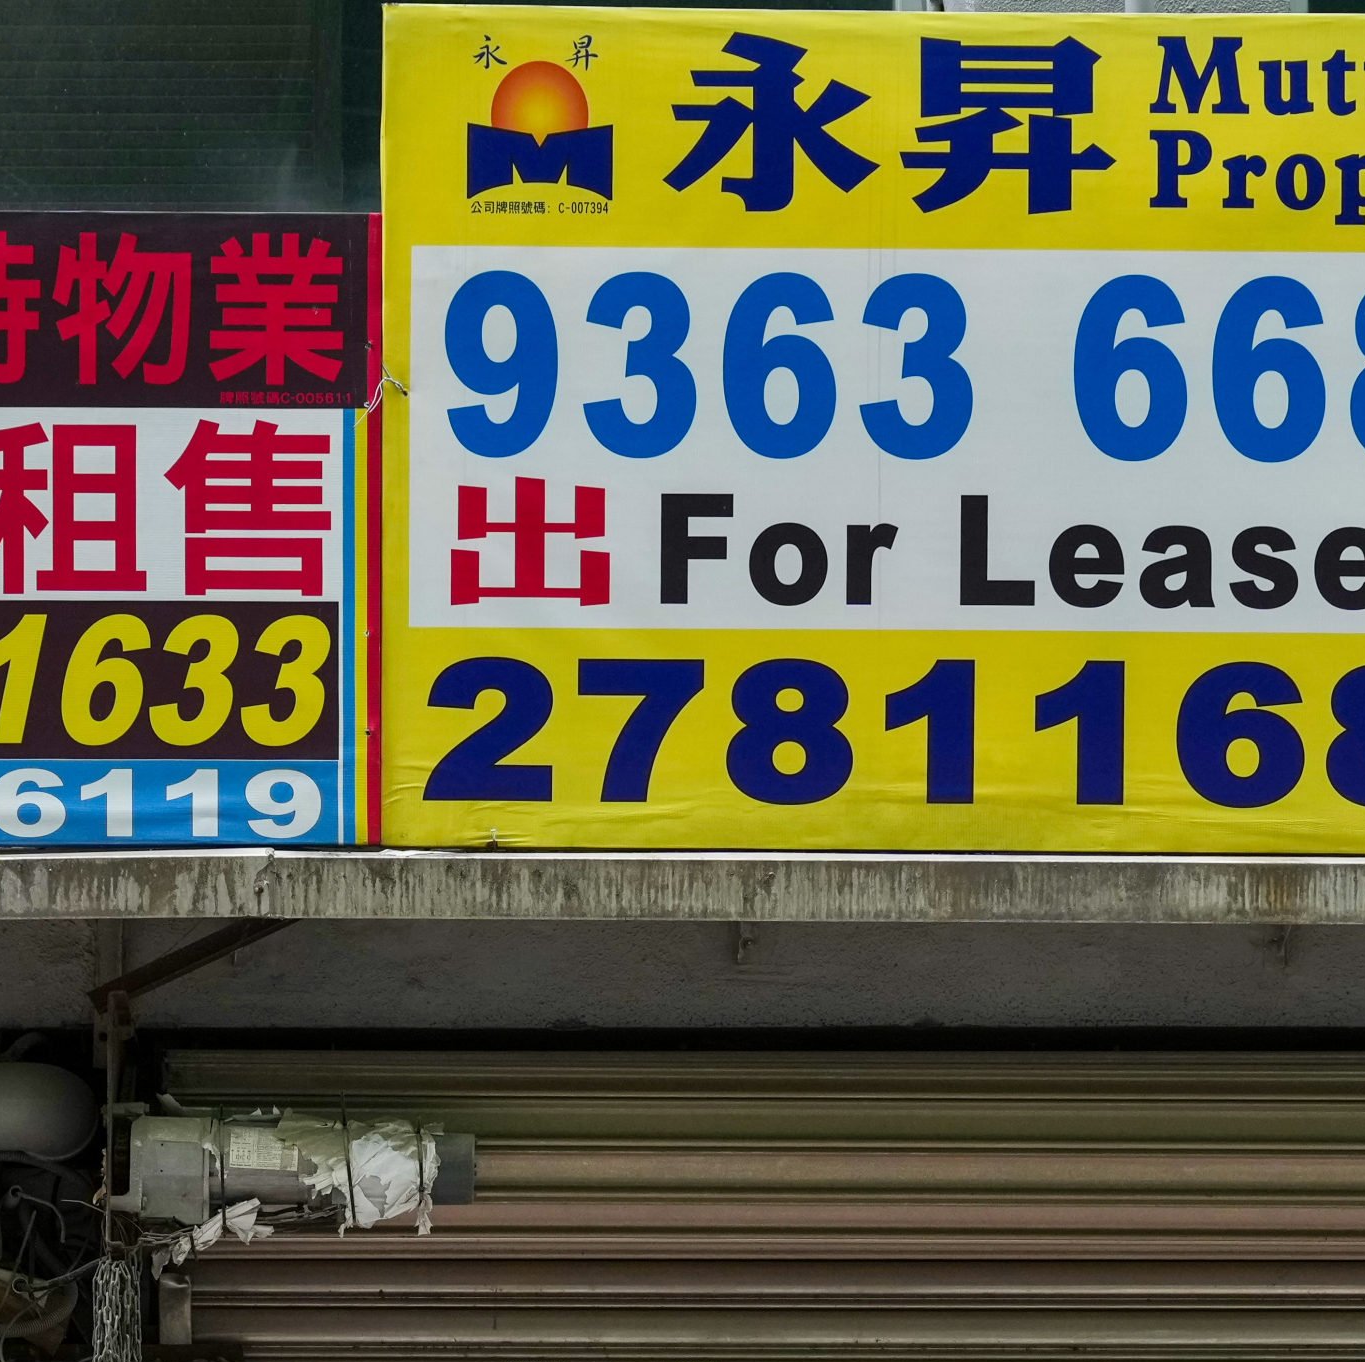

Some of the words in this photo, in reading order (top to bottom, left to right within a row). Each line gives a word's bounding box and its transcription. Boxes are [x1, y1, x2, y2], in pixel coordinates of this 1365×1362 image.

[473, 35, 507, 69] 永
[565, 35, 598, 71] 昇
[663, 32, 1117, 216] 永昇
[559, 202, 608, 213] C-007394
[445, 270, 974, 462] 9363
[450, 477, 611, 606] 出
[660, 493, 899, 607] For
